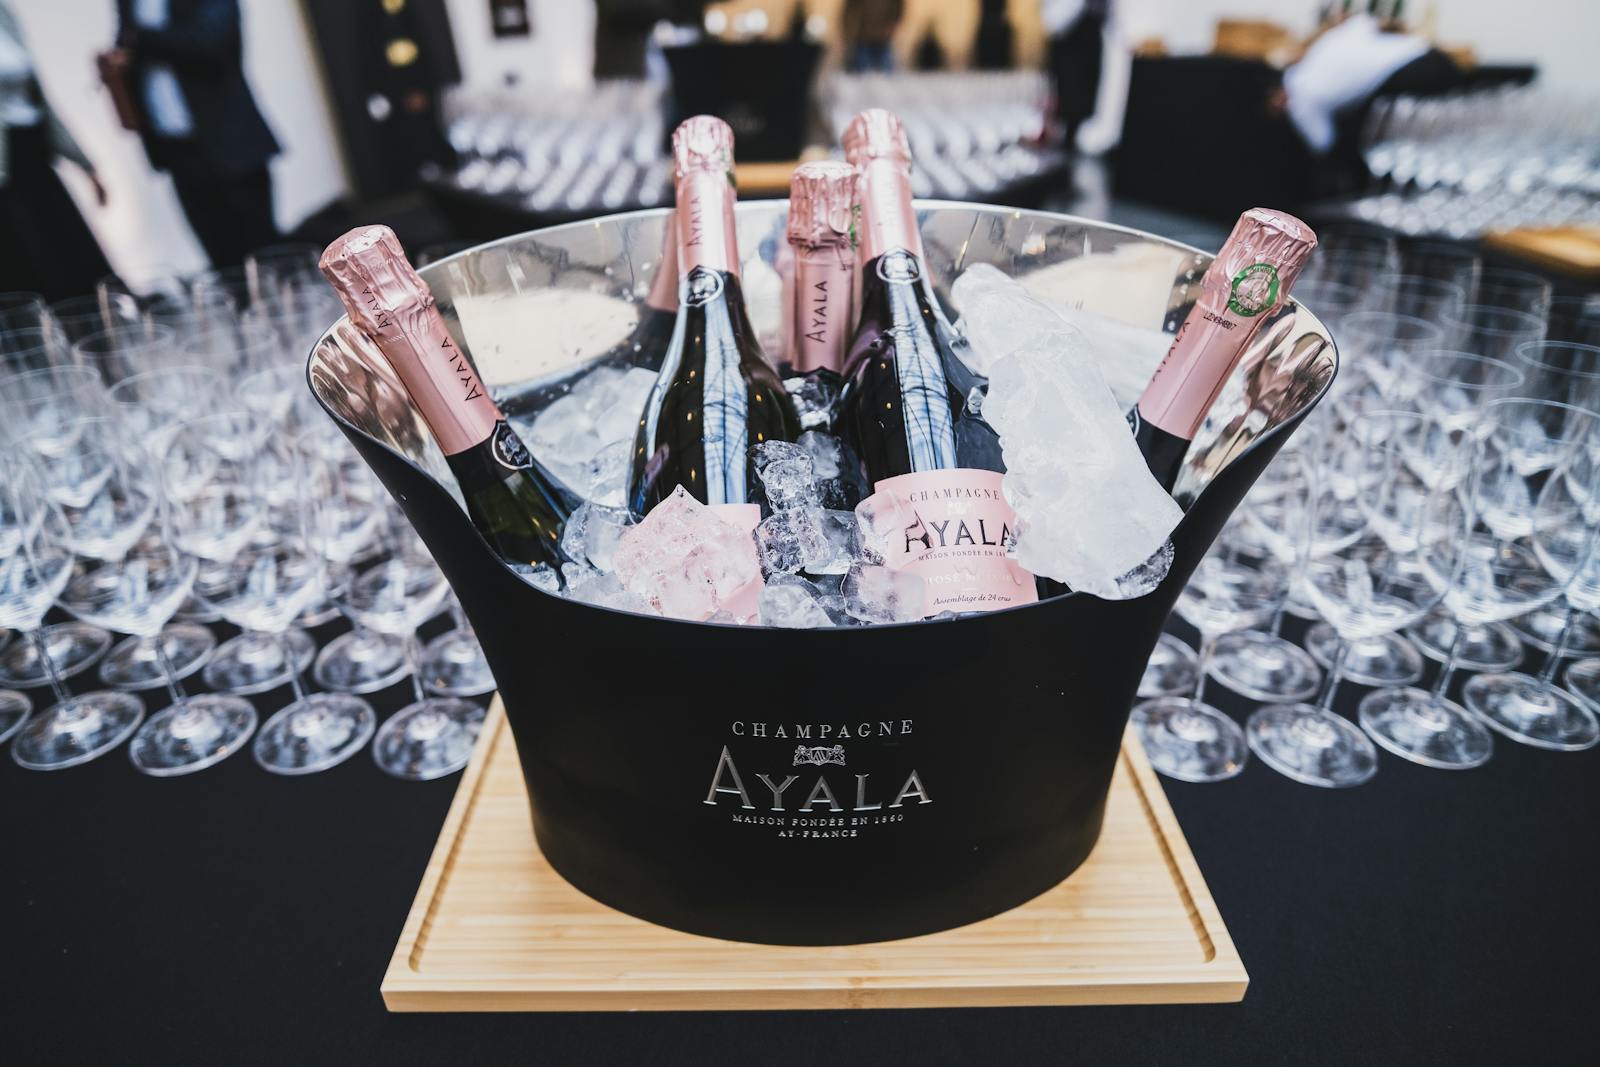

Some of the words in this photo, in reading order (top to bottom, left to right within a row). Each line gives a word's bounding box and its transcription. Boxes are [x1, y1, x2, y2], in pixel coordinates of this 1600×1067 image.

[362, 286, 393, 330] AYALA
[806, 280, 828, 344] AYALA
[441, 336, 483, 403] AYALA
[909, 487, 1000, 503] CHAMPAGNE
[933, 594, 977, 606] Assemblage
[987, 593, 997, 601] 24
[731, 719, 914, 739] CHAMPAGNE
[703, 744, 933, 812] AYALA
[732, 814, 785, 826] MAISON
[791, 816, 846, 827] FONDÉE
[851, 817, 869, 826] EN
[778, 829, 858, 838] AY-FRANCE
